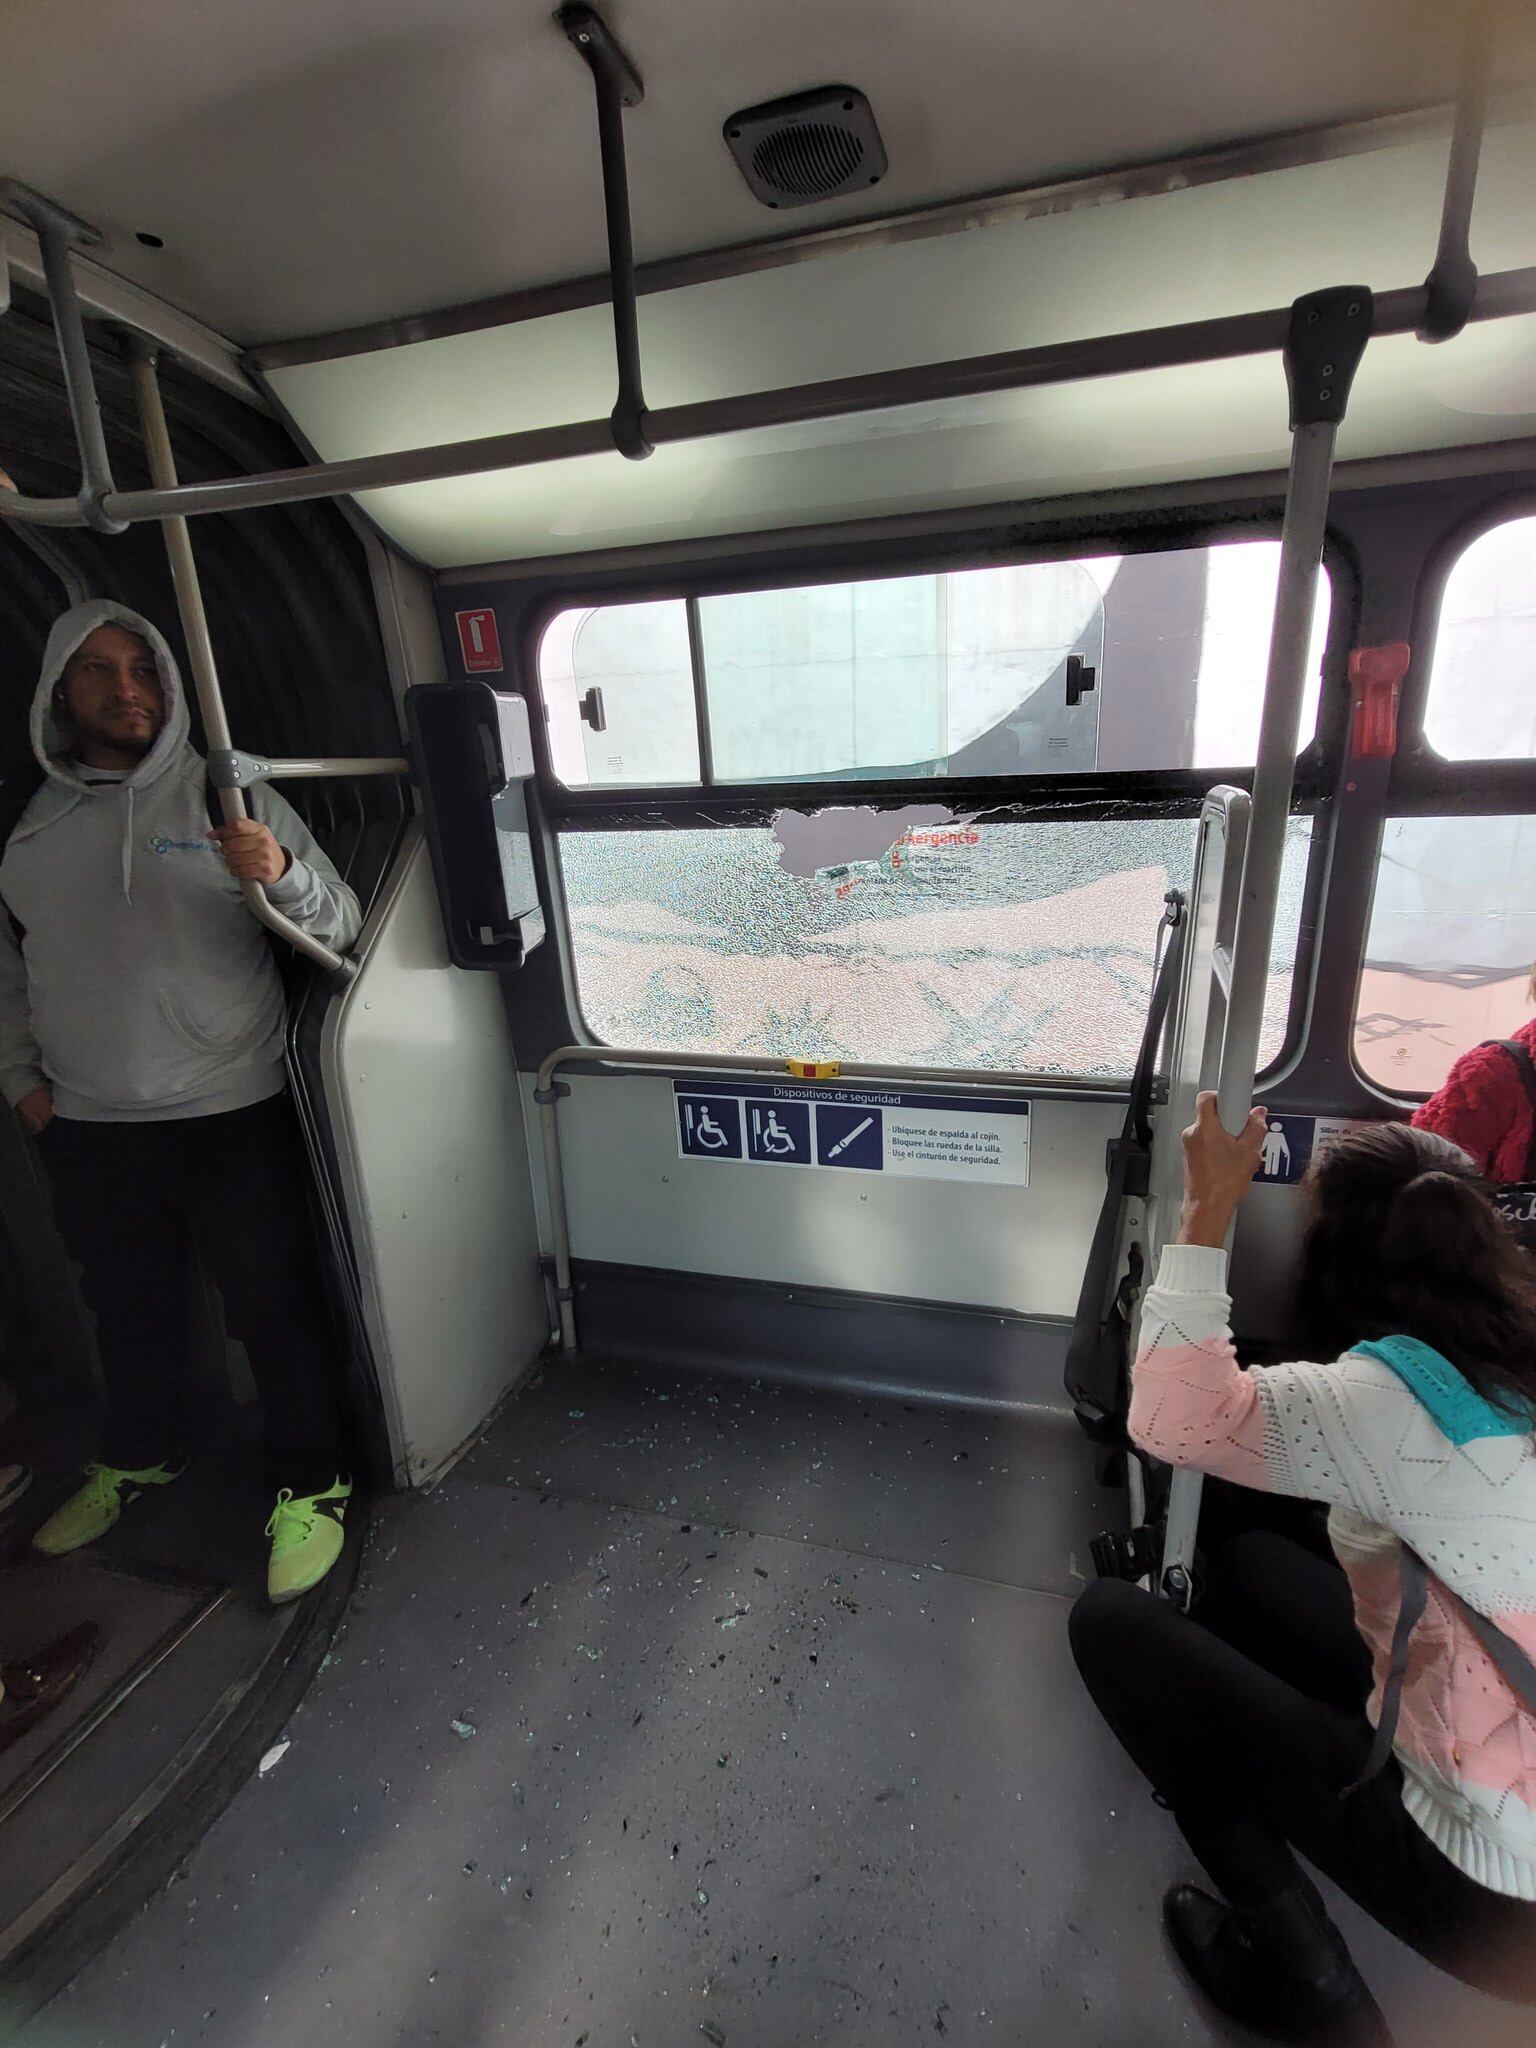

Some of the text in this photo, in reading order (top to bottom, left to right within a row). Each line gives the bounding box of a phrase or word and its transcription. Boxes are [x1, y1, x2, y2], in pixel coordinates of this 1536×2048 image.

[773, 1087, 901, 1104] Dispositivos de seguridad
[928, 1128, 938, 1136] de
[939, 1129, 969, 1140] espalda
[970, 1131, 979, 1140] al
[892, 1137, 1003, 1154] Bloquee las ruedas de la silla.
[892, 1149, 906, 1158] Use
[907, 1150, 914, 1158] el
[948, 1152, 959, 1161] de
[960, 1154, 1001, 1165] seguridad.
